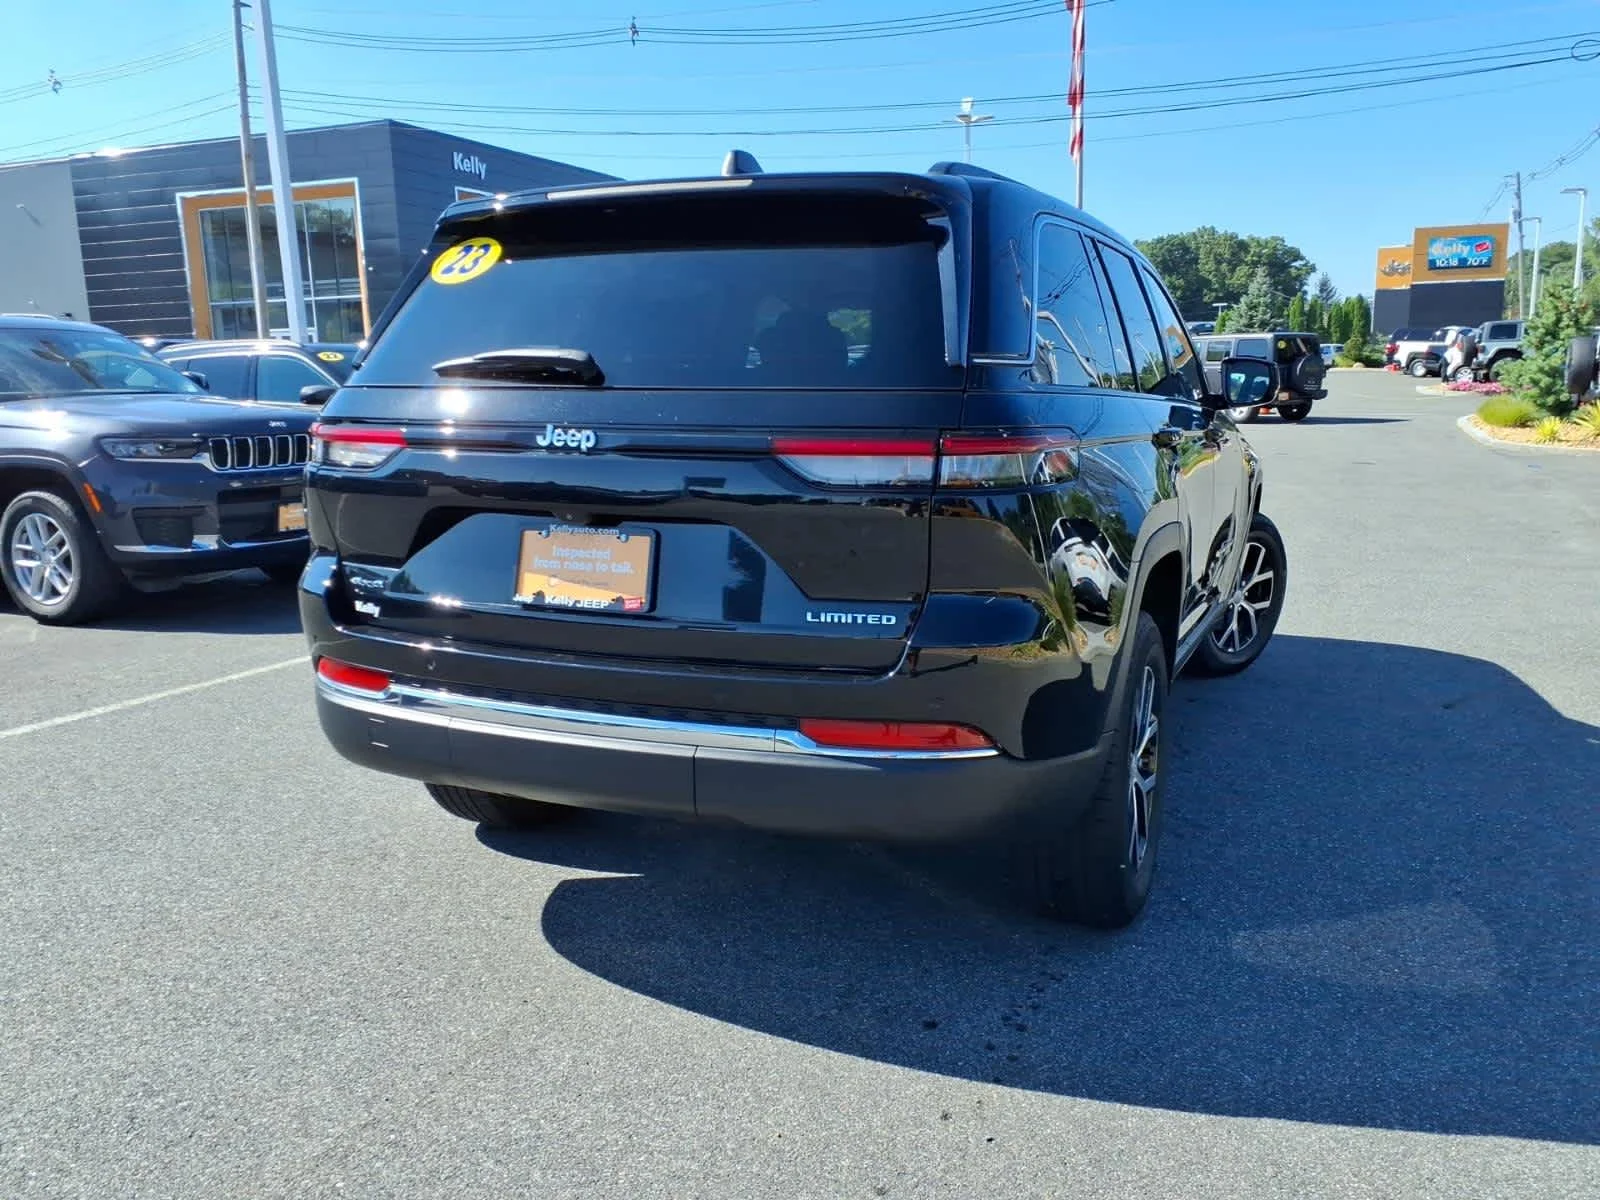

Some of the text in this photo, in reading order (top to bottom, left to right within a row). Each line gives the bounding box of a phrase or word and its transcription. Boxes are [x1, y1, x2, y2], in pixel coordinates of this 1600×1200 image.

[453, 151, 486, 180] Kelly
[441, 244, 491, 275] 23
[1436, 257, 1458, 268] 10:18
[535, 423, 596, 453] Jeep
[549, 523, 620, 536] Kellyauto.com
[553, 545, 612, 561] Inspected
[534, 556, 561, 570] from
[564, 561, 593, 572] nose
[595, 561, 609, 573] to
[544, 595, 575, 608] Kelly
[576, 600, 611, 609] JEEP
[806, 611, 897, 625] LIMITED
